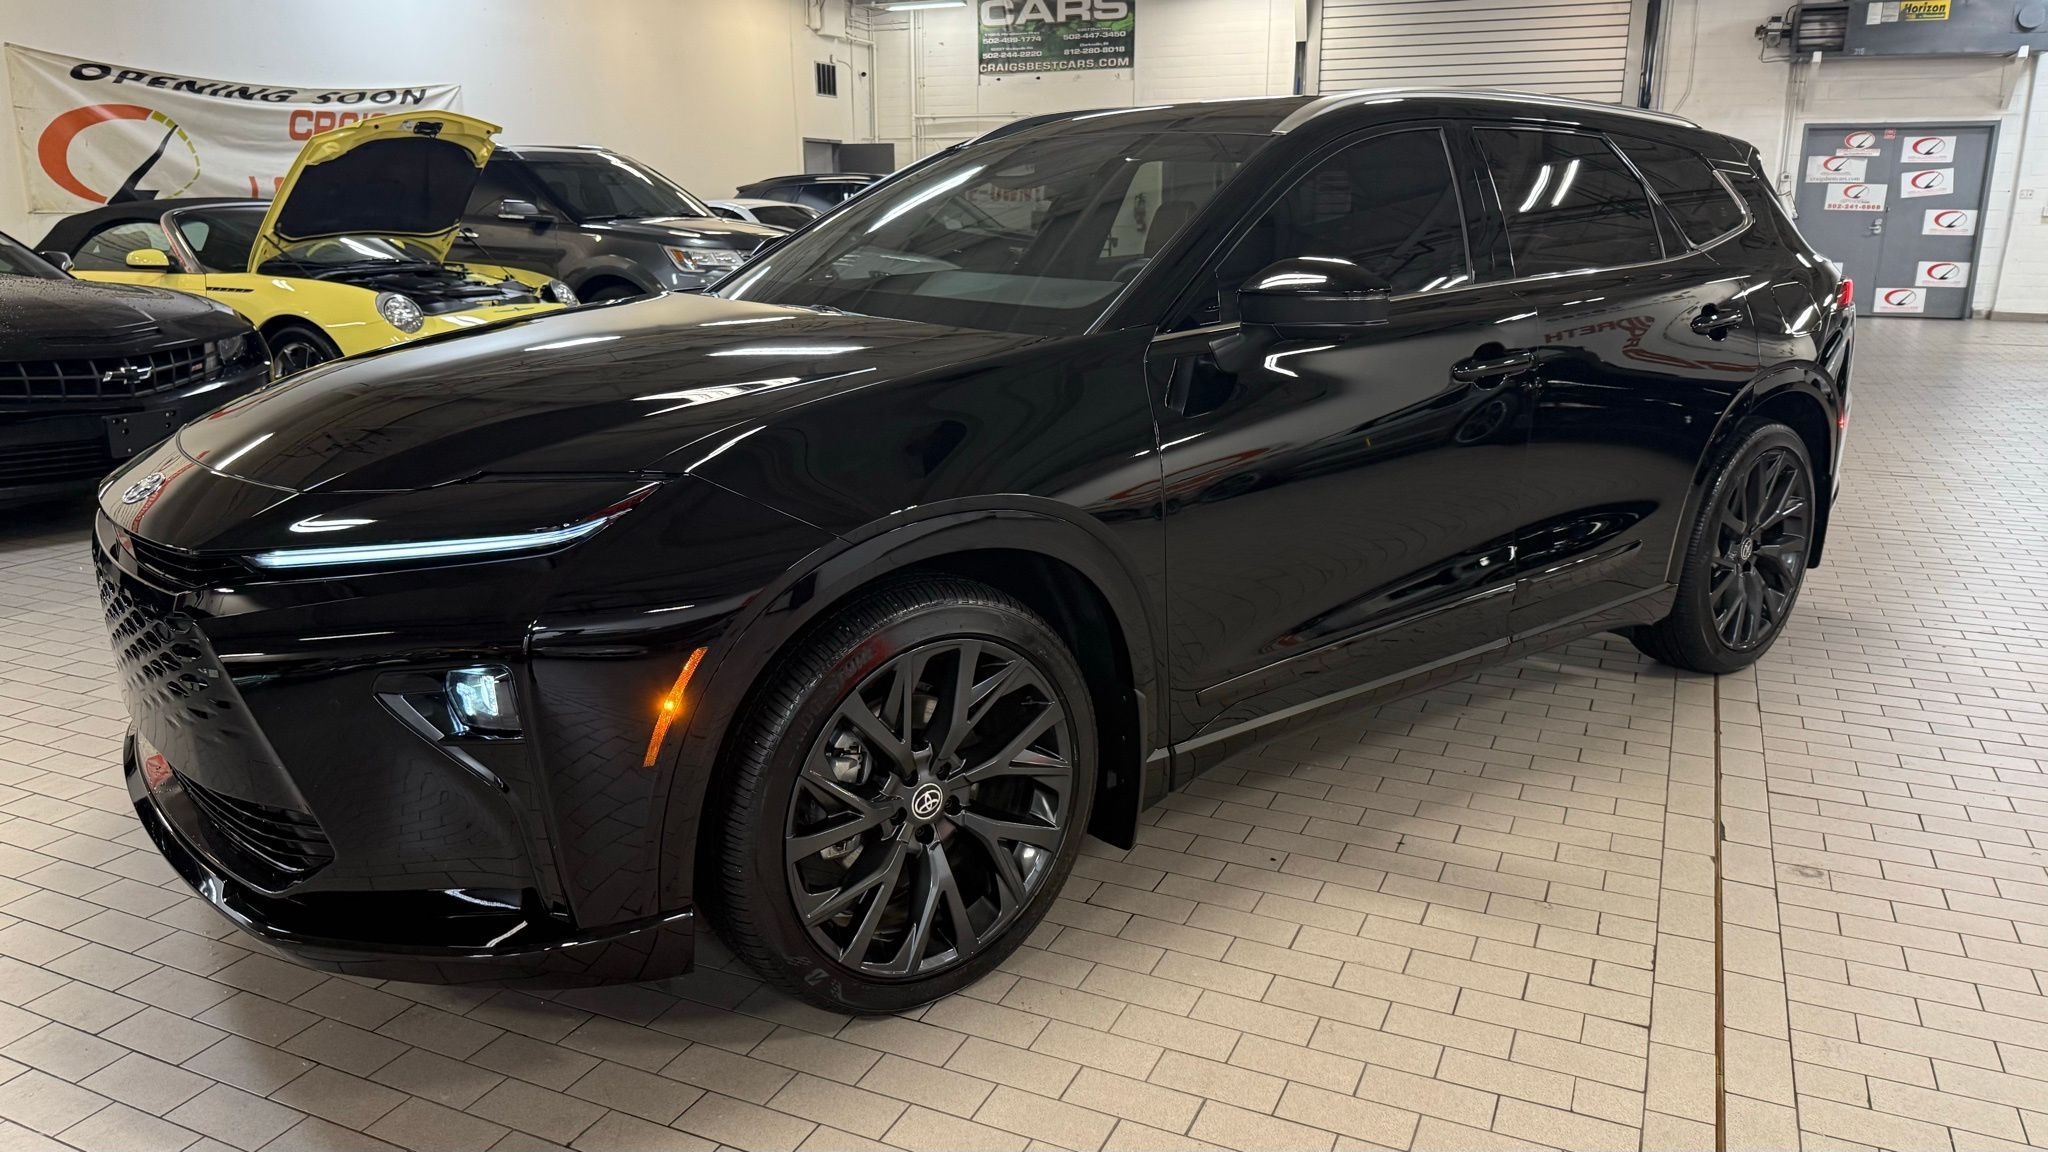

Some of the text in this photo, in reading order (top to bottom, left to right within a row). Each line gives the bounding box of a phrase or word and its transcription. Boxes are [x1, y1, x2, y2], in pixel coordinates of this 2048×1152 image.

[980, 0, 1128, 26] CARS
[1904, 2, 1946, 13] Horizon
[1063, 31, 1127, 40] 502-447-3450
[979, 57, 1130, 73] CRAIGSBESTCARS.COM
[69, 63, 427, 105] OPENING SOON
